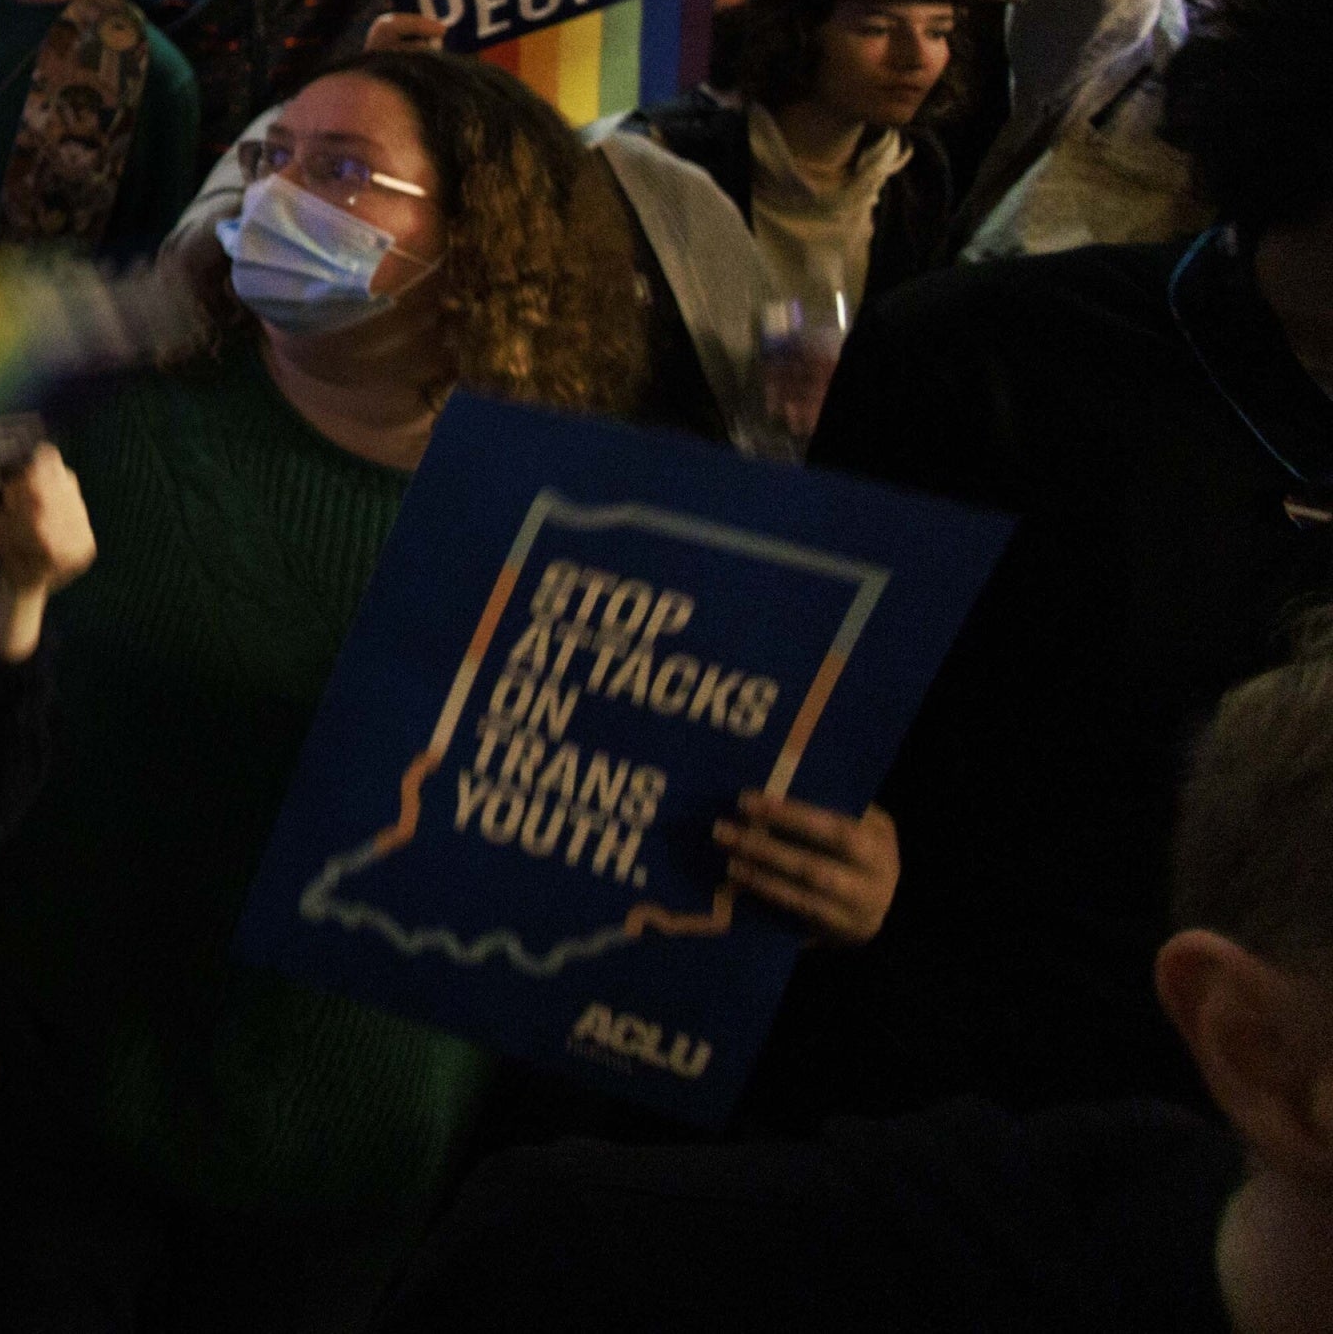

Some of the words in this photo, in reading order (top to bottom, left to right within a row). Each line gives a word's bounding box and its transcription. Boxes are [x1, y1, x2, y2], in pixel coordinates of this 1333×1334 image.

[533, 561, 695, 637] STOP
[488, 674, 580, 740] ON
[509, 618, 780, 737] ATTACKS
[474, 716, 667, 828] TRANS
[455, 770, 647, 888] YOUTH.
[574, 1002, 712, 1078] ACLU
